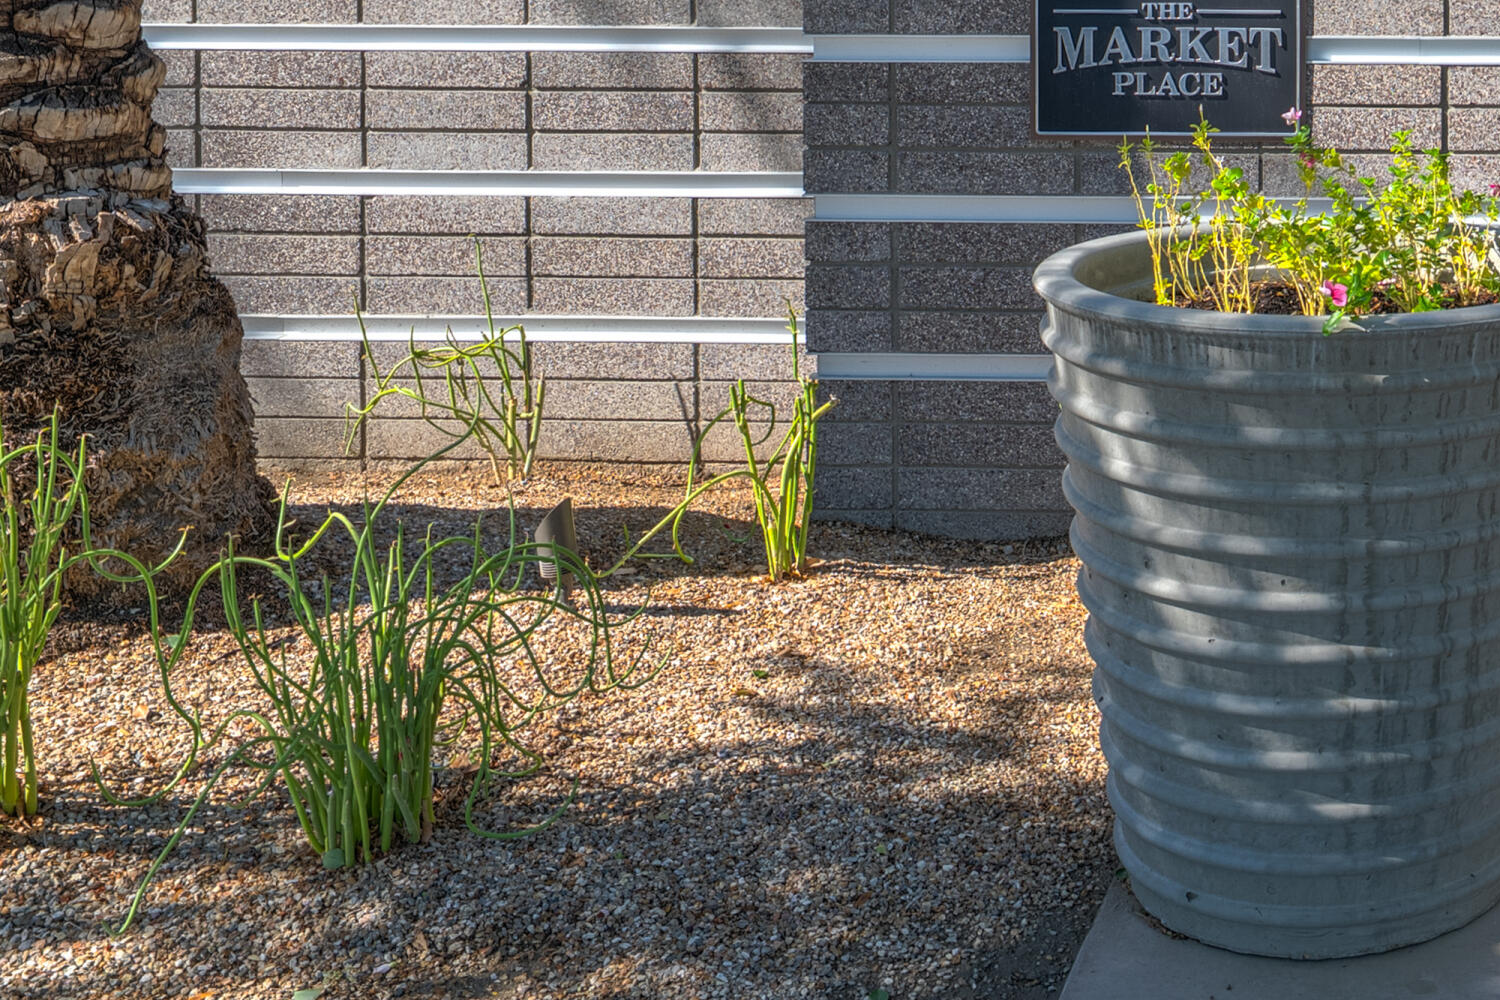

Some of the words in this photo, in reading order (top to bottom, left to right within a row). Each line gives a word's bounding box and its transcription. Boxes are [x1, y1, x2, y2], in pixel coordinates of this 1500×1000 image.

[1141, 2, 1194, 20] THE
[1052, 26, 1283, 74] MARKET
[1112, 72, 1223, 96] PLACE
